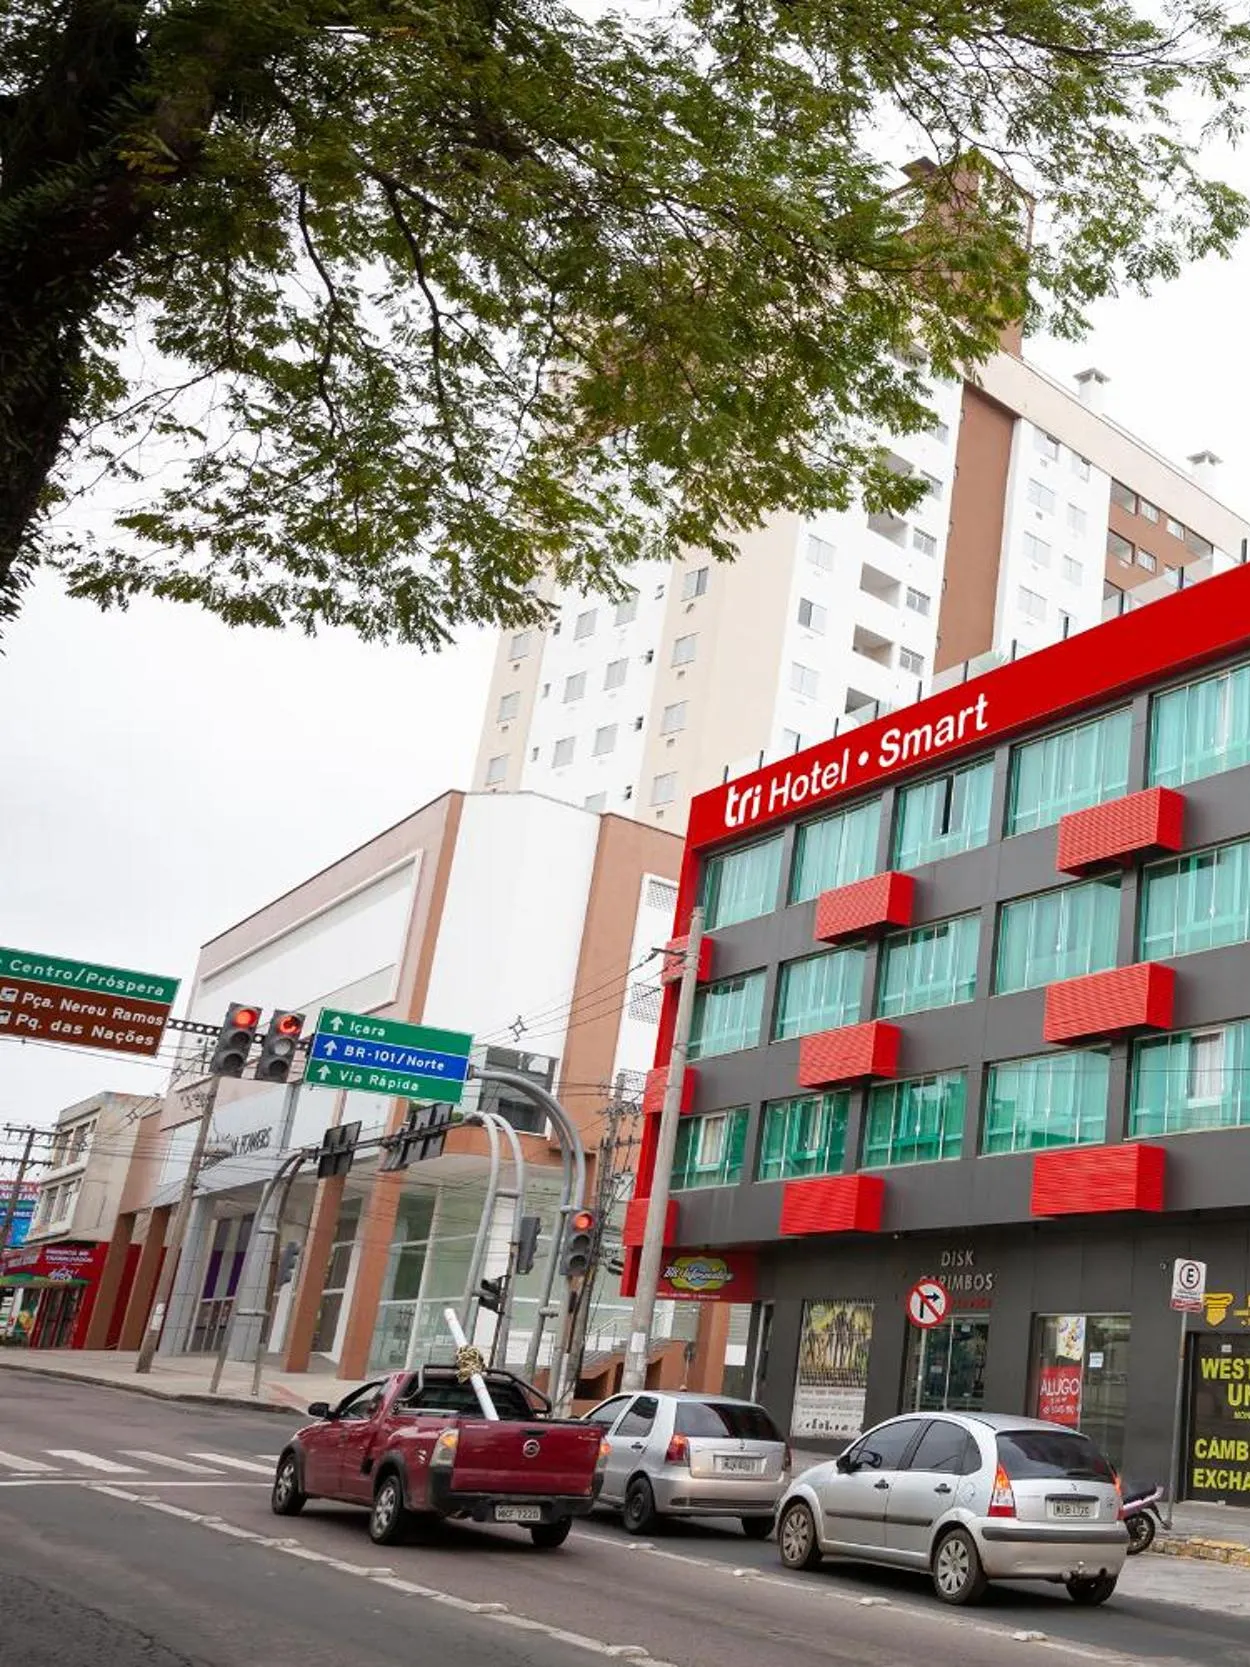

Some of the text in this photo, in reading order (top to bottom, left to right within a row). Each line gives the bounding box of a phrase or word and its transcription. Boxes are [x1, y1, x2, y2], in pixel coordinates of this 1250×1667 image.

[724, 692, 990, 828] tri Hotel Smart
[9, 959, 165, 997] Centro/Próspera
[22, 991, 165, 1027] Pça. Nereu Ramos
[15, 1013, 155, 1046] Pq. das Nações
[350, 1020, 386, 1038] Içara
[344, 1044, 446, 1071] BR-101/Norte
[339, 1070, 420, 1091] Via Rápida
[941, 1250, 975, 1267] DISK
[920, 1273, 994, 1291] RIMBOS
[1186, 1267, 1195, 1284] E
[1040, 1378, 1080, 1396] ALUGO
